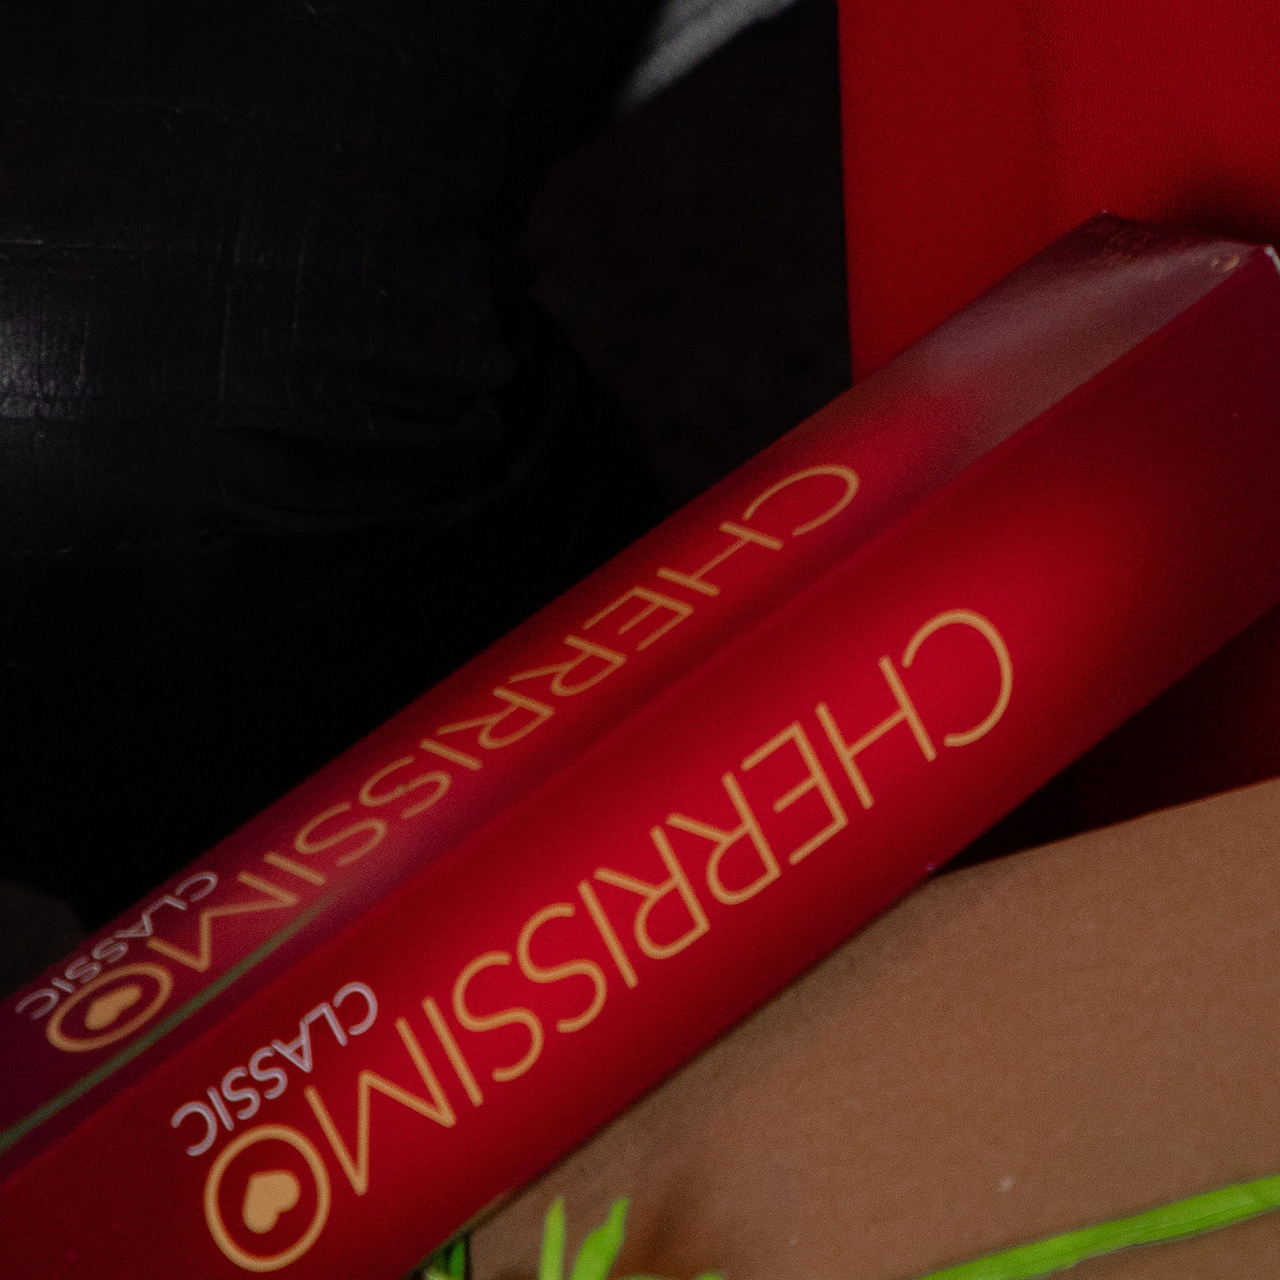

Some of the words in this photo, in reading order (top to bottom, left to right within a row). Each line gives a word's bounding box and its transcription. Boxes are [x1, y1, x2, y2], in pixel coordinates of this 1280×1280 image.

[13, 867, 222, 1024] CLASSIC
[45, 462, 862, 1056] CHERRISSIMO
[202, 606, 1015, 1275] CHERRISSIMO
[168, 978, 381, 1160] CLASSIC
